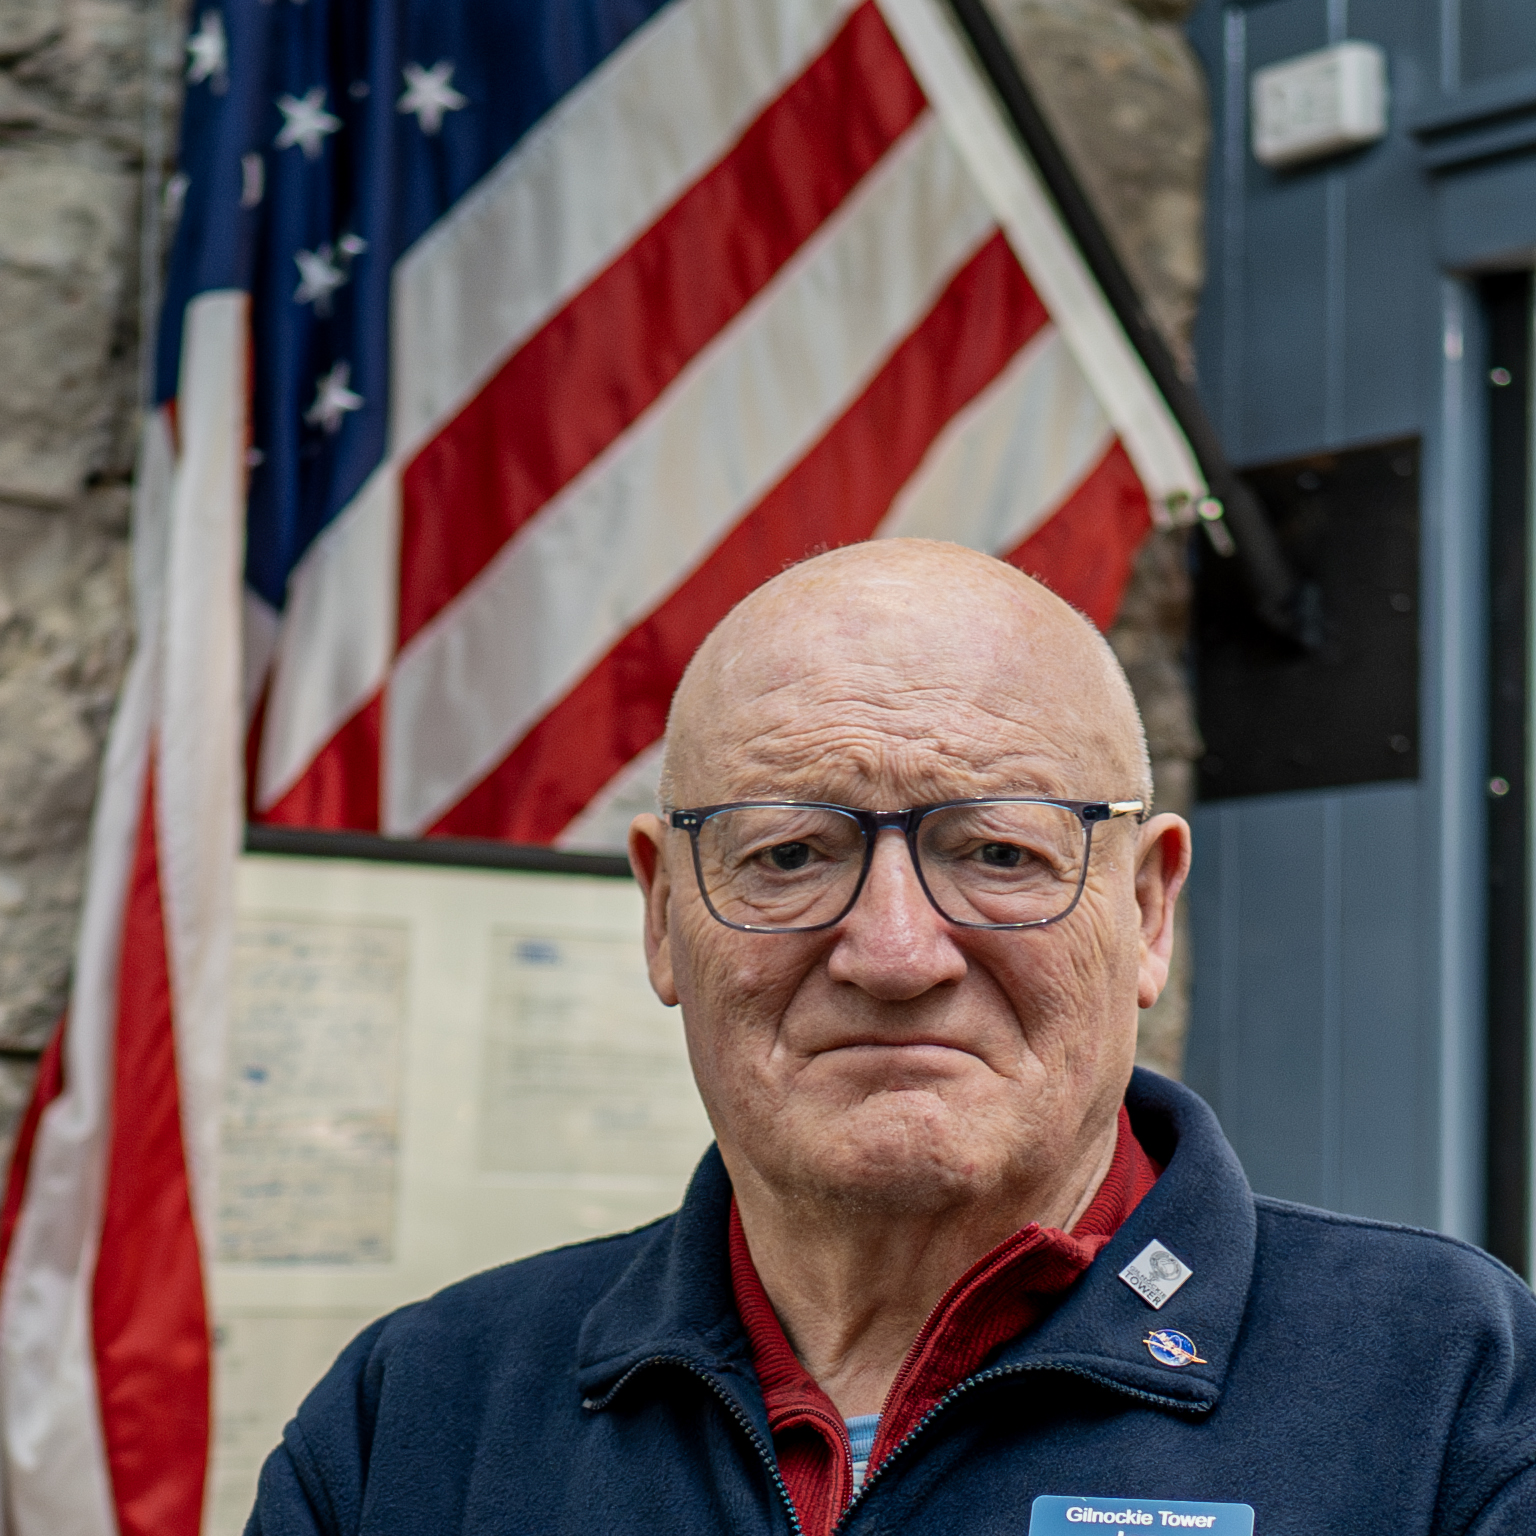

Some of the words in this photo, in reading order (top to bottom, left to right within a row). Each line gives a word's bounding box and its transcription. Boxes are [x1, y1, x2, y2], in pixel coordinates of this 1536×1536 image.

[1123, 1269, 1162, 1306] TOWER
[1065, 1506, 1154, 1526] Gilnockie
[1158, 1510, 1217, 1529] Tower
